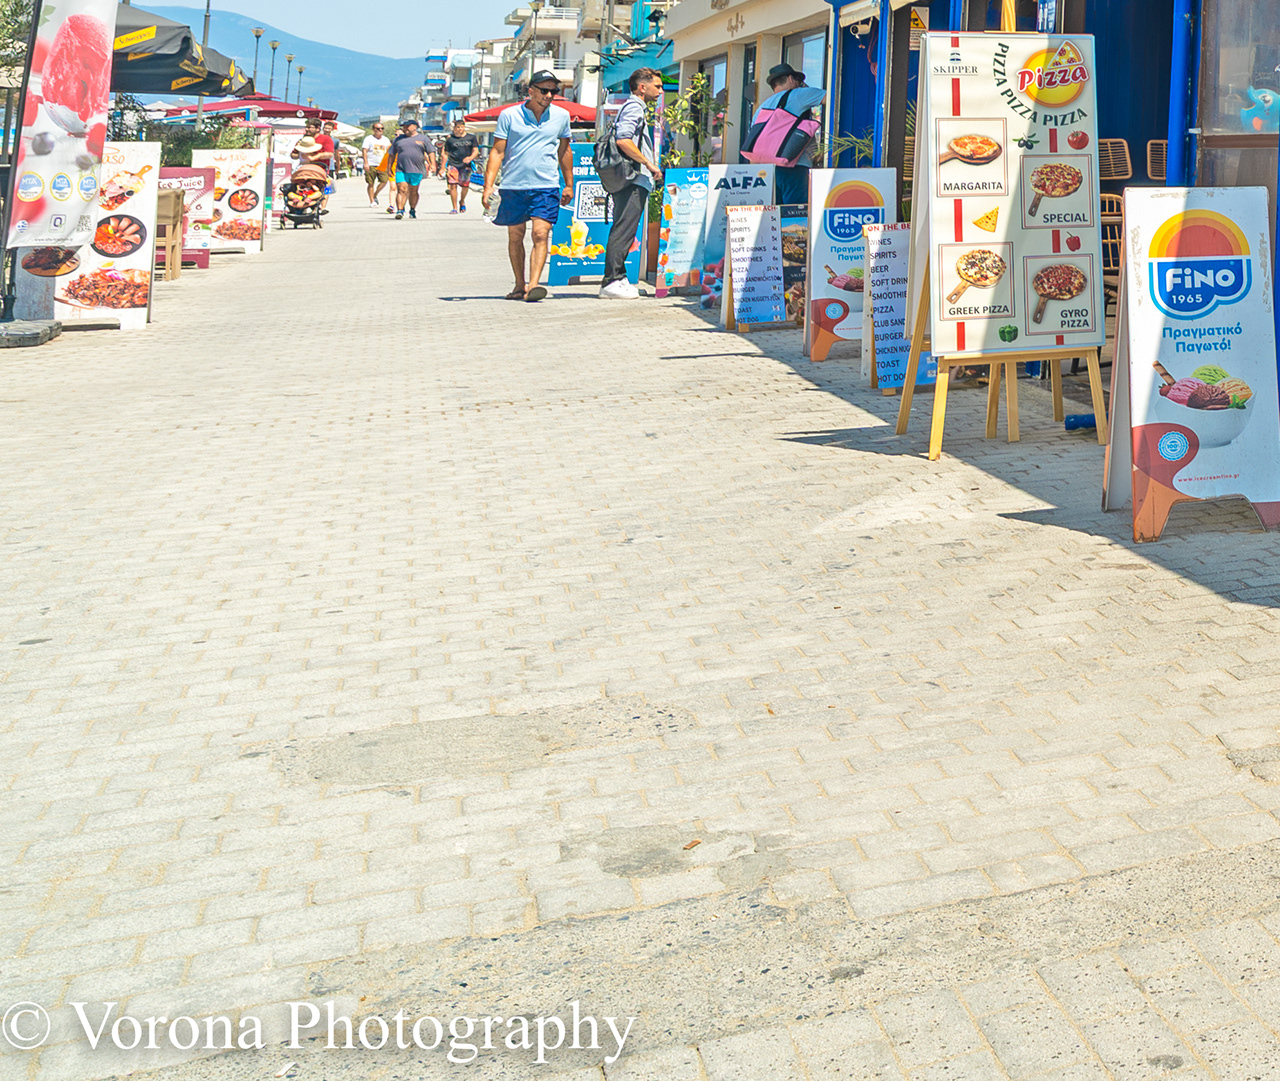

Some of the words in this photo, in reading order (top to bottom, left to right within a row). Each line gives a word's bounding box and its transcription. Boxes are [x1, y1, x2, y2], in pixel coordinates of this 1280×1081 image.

[933, 65, 978, 74] SKIPPER
[993, 42, 1010, 87] PIZZA
[1018, 66, 1088, 92] Pizza
[1000, 88, 1037, 123] PIZZA
[1043, 108, 1088, 127] PIZZA
[102, 153, 126, 165] aso
[177, 178, 203, 190] Juice
[714, 176, 767, 191] ALFA
[943, 182, 1003, 191] MARGARITA
[833, 213, 875, 227] FiNO
[1043, 213, 1088, 223] SPECIAL
[882, 223, 899, 231] THE
[869, 237, 892, 246] WINES
[831, 246, 865, 256] Πραγματ
[870, 251, 897, 259] SPIRITS
[838, 253, 865, 262] Παγωτ
[870, 265, 889, 273] BEER
[871, 279, 889, 287] SOFT
[891, 277, 908, 286] DRIN
[1165, 268, 1236, 292] FiNO
[872, 290, 907, 300] SMOOTHIE
[1172, 294, 1203, 303] 1965
[873, 306, 895, 314] PIZZA
[948, 306, 980, 315] GREEK
[982, 305, 1009, 314] PIZZA
[1060, 309, 1089, 319] GYRO
[874, 319, 889, 327] CLUB
[1060, 320, 1089, 328] PIZZA
[1162, 322, 1242, 340] Πραγματικό
[875, 332, 904, 341] BURGER
[875, 346, 898, 354] CHICKEN
[1176, 340, 1231, 354] Παγωτό!
[876, 360, 900, 368] TOAST
[878, 374, 891, 382] HOT
[1178, 473, 1240, 483] www.icecreamfino.gr
